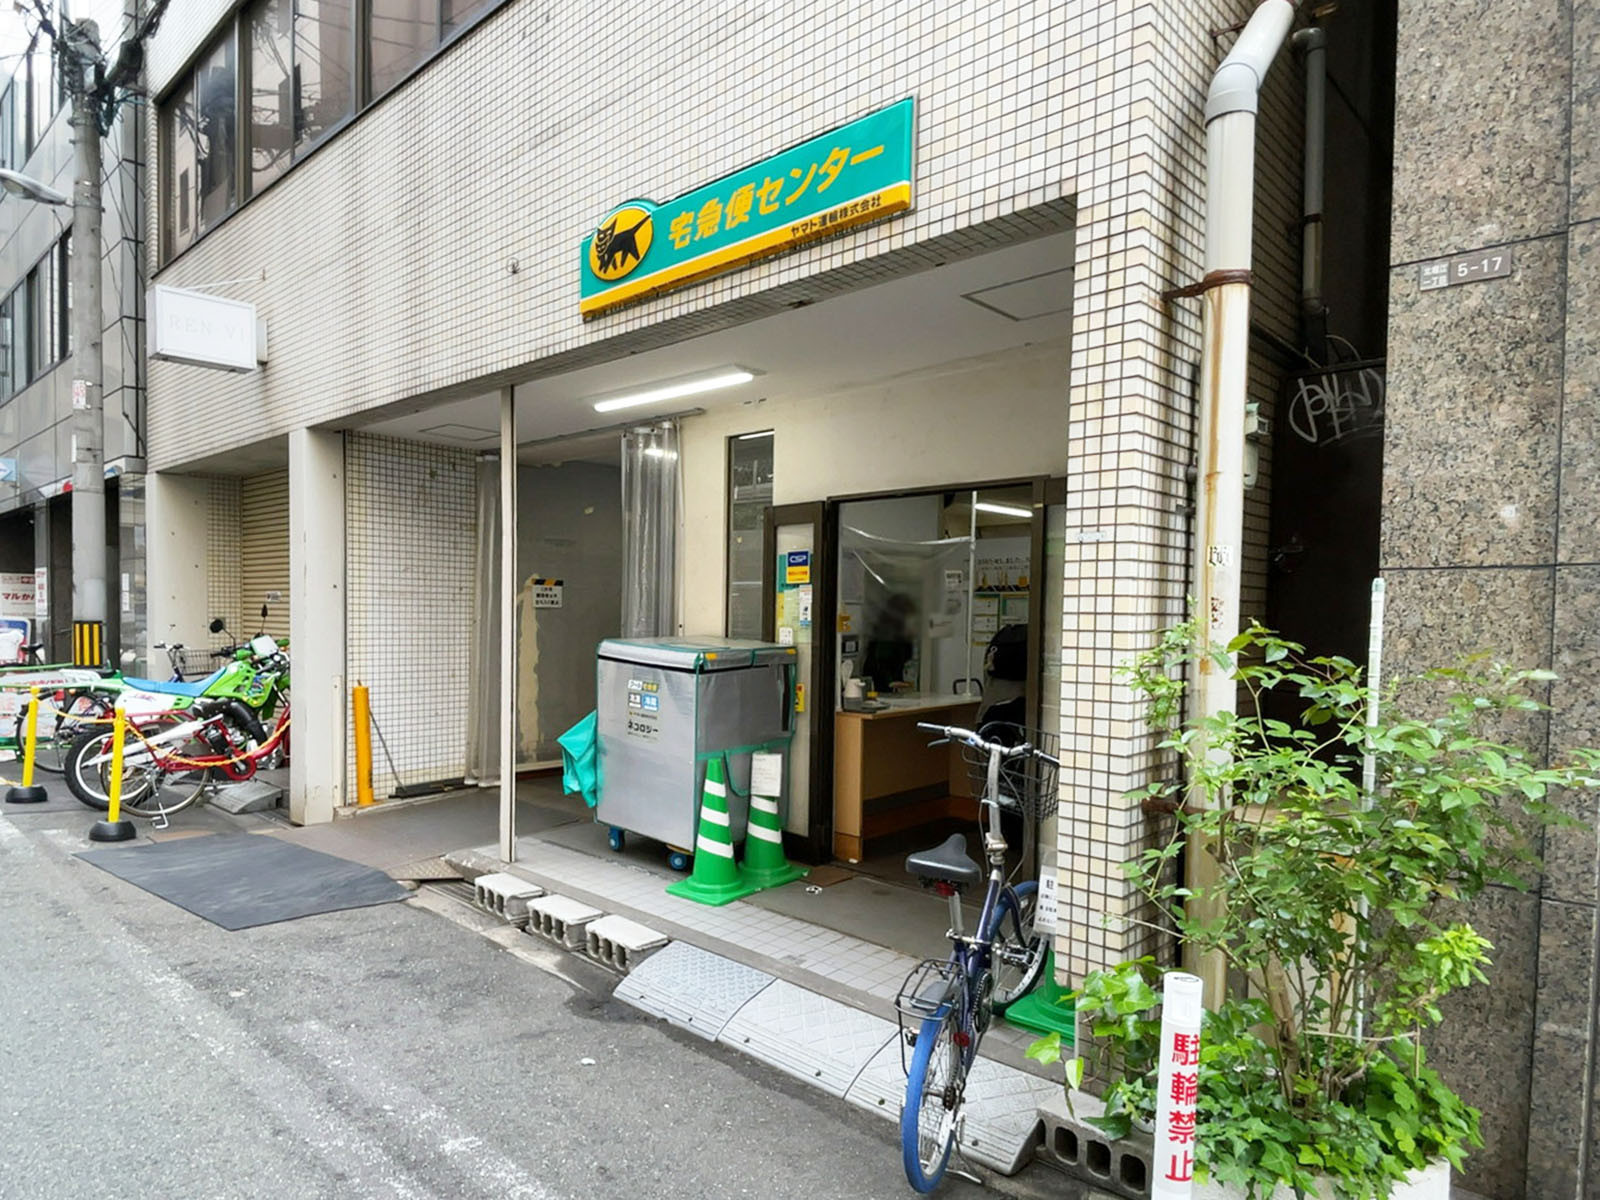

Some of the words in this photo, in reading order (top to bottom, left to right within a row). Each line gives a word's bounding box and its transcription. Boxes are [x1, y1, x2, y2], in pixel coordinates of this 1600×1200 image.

[669, 145, 884, 249] 宅急便センター
[791, 195, 882, 237] ヤマト運輸株式会社
[1457, 257, 1502, 277] 5-17
[628, 720, 658, 733] ネコロジー
[1165, 1032, 1201, 1182] 駐輪禁止
